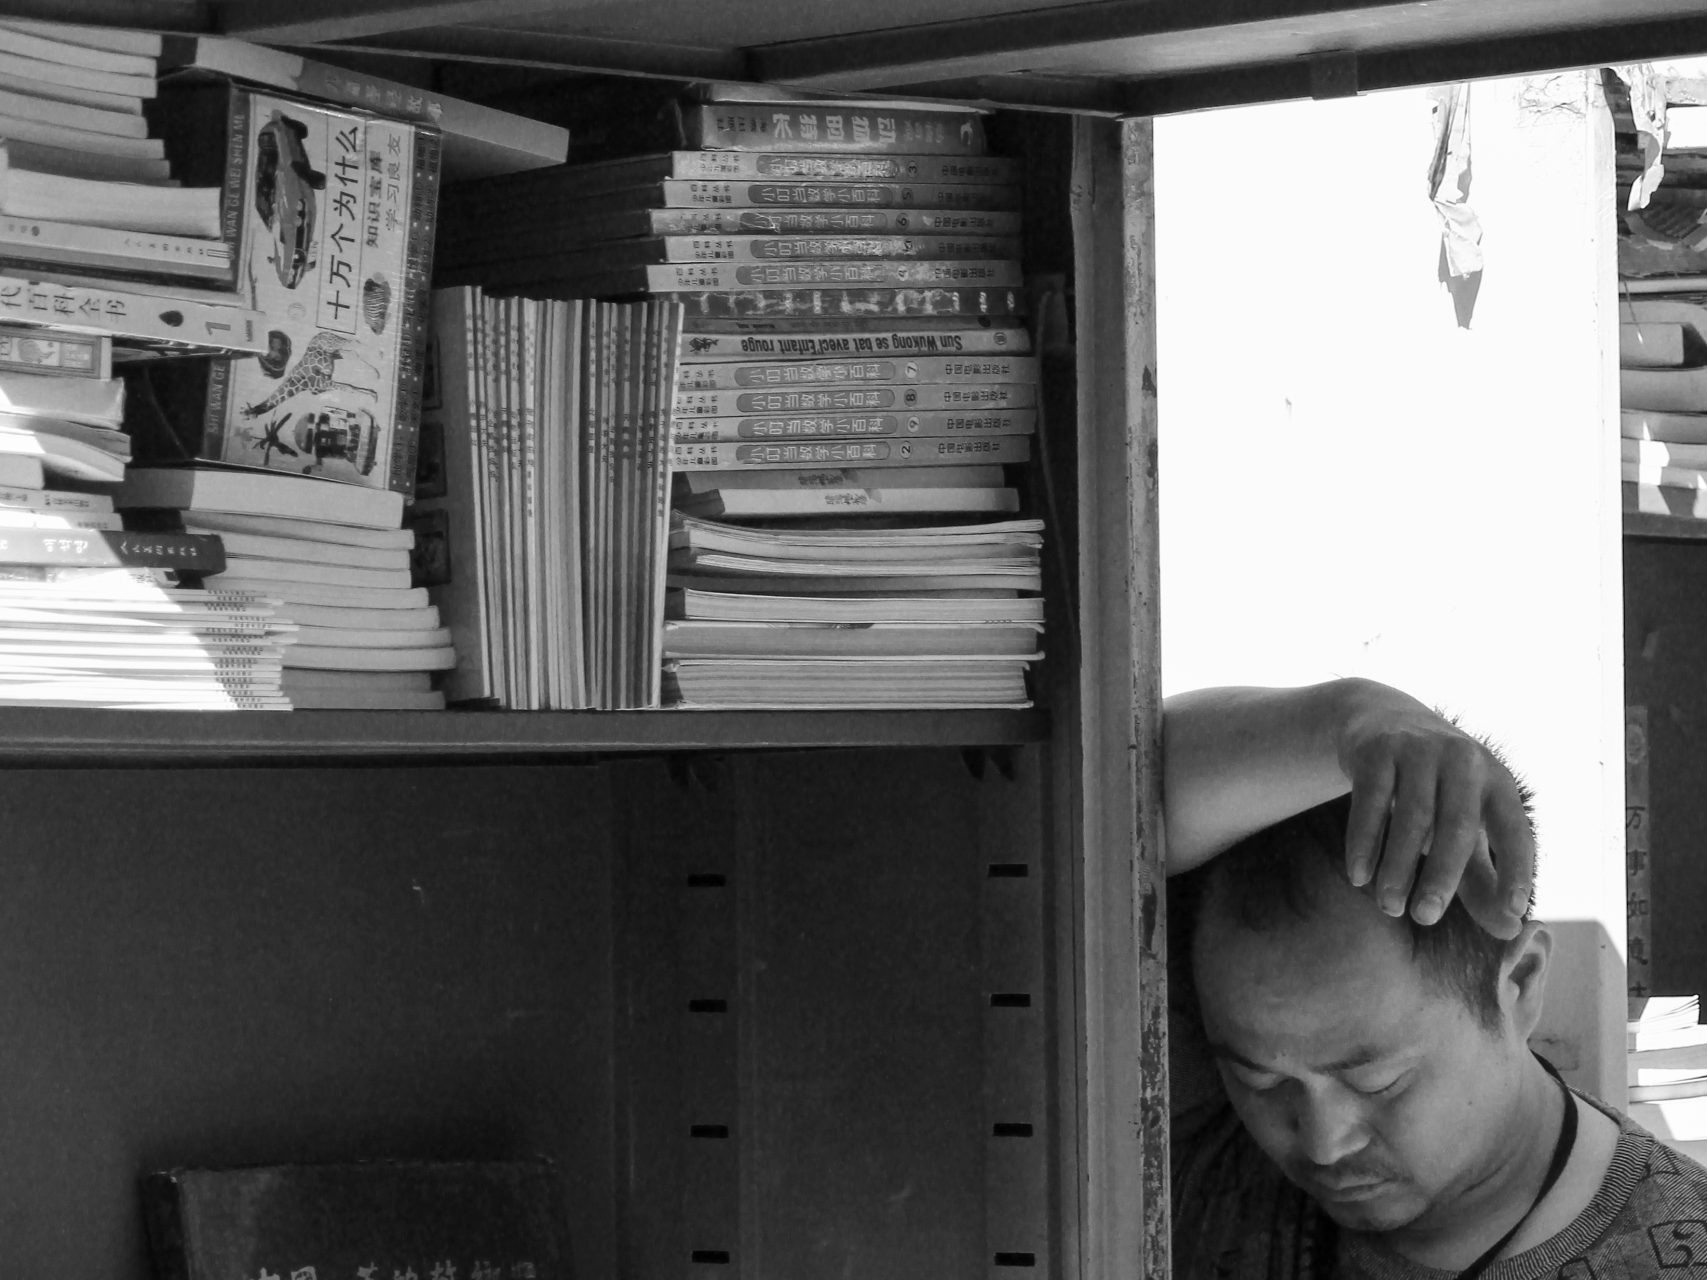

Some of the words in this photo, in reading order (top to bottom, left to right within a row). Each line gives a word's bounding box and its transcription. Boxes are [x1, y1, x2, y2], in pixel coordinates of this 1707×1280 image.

[384, 132, 402, 233] 学习良友
[365, 150, 384, 249] 知识宝库
[224, 211, 239, 240] WAN
[327, 125, 359, 321] 十万个为什么
[205, 320, 232, 337] 1
[740, 338, 775, 353] rouge
[852, 337, 873, 352] bat
[875, 337, 889, 349] se
[892, 334, 937, 354] Wukong
[939, 334, 963, 352] Sun
[750, 362, 883, 383] 小叮当数学小百科
[209, 384, 223, 412] WAN
[751, 390, 882, 410] 小叮当数学小百科
[753, 416, 884, 435] 小叮当数学小百科
[750, 442, 879, 461] 小叮当数学小百科
